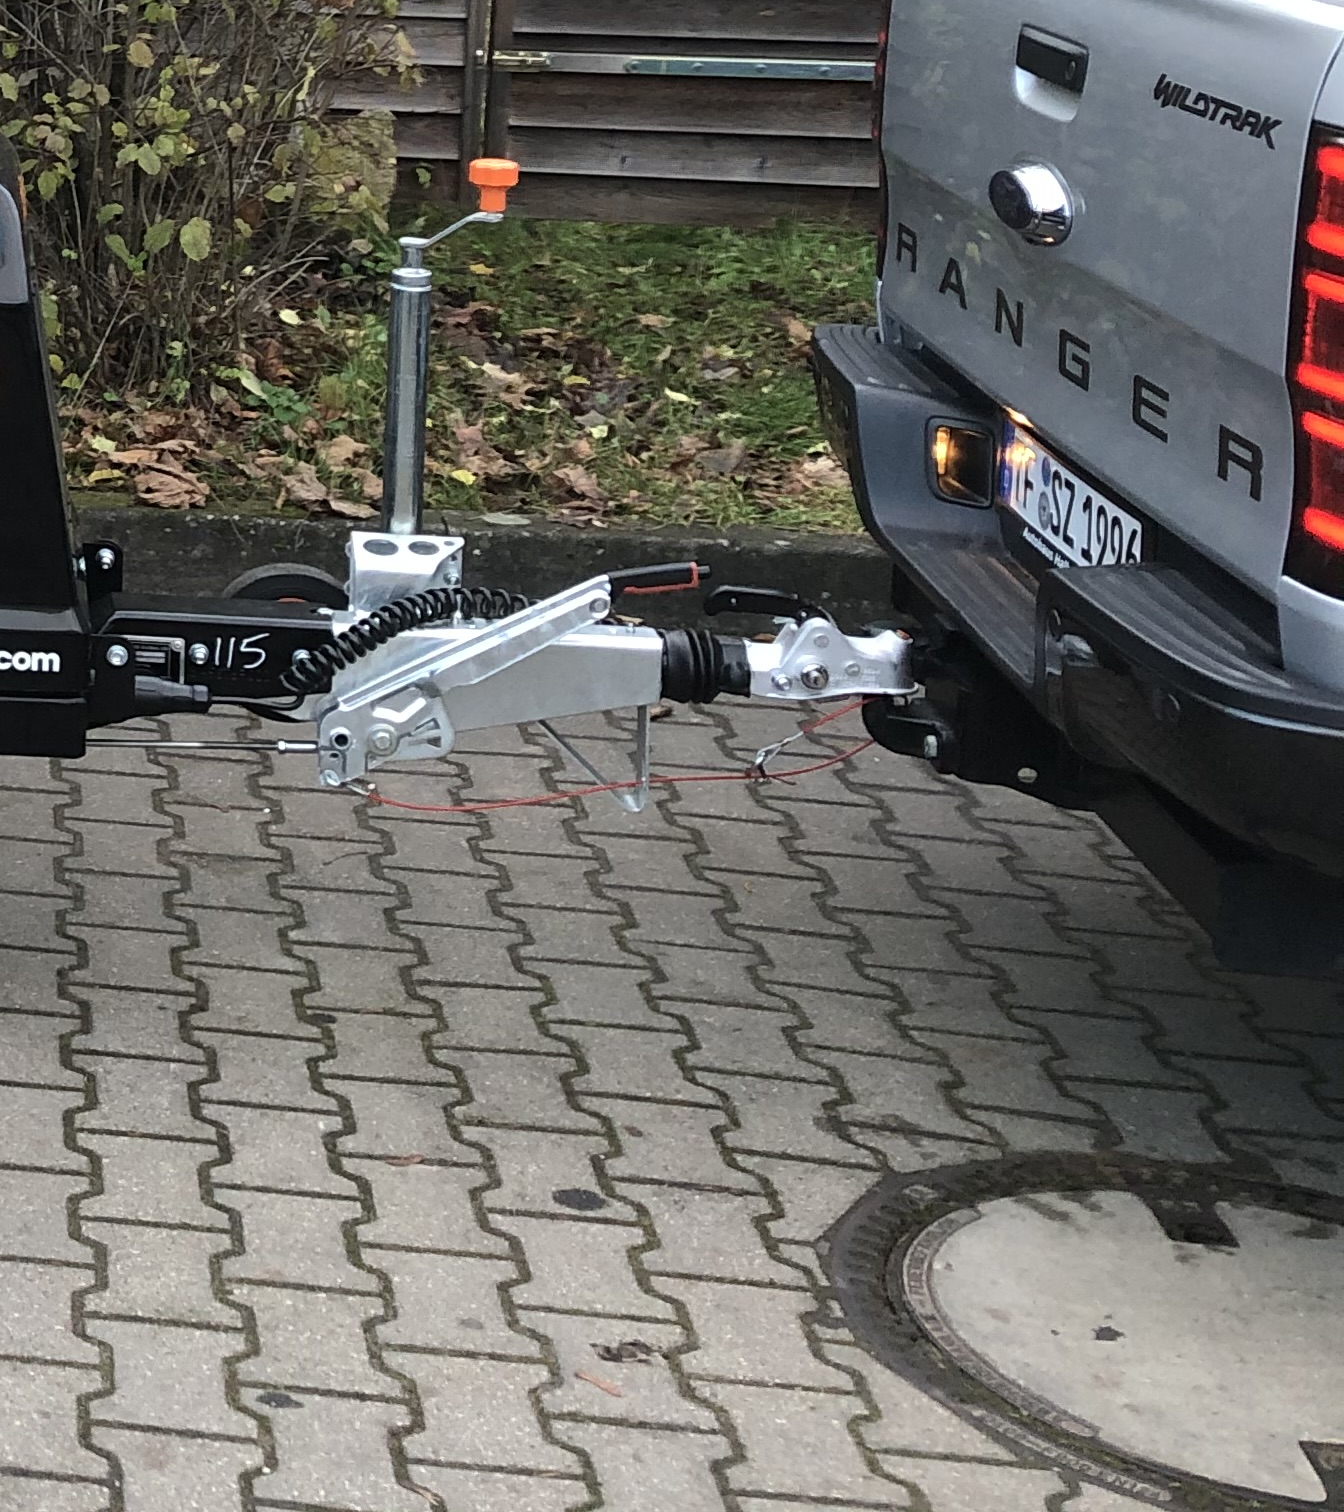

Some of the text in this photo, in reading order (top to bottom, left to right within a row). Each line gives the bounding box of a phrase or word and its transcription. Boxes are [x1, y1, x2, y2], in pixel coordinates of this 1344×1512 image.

[1152, 73, 1282, 150] WILDTRAK
[895, 222, 1264, 503] RANGER
[1050, 469, 1076, 549] SZ
[214, 633, 270, 669] 115
